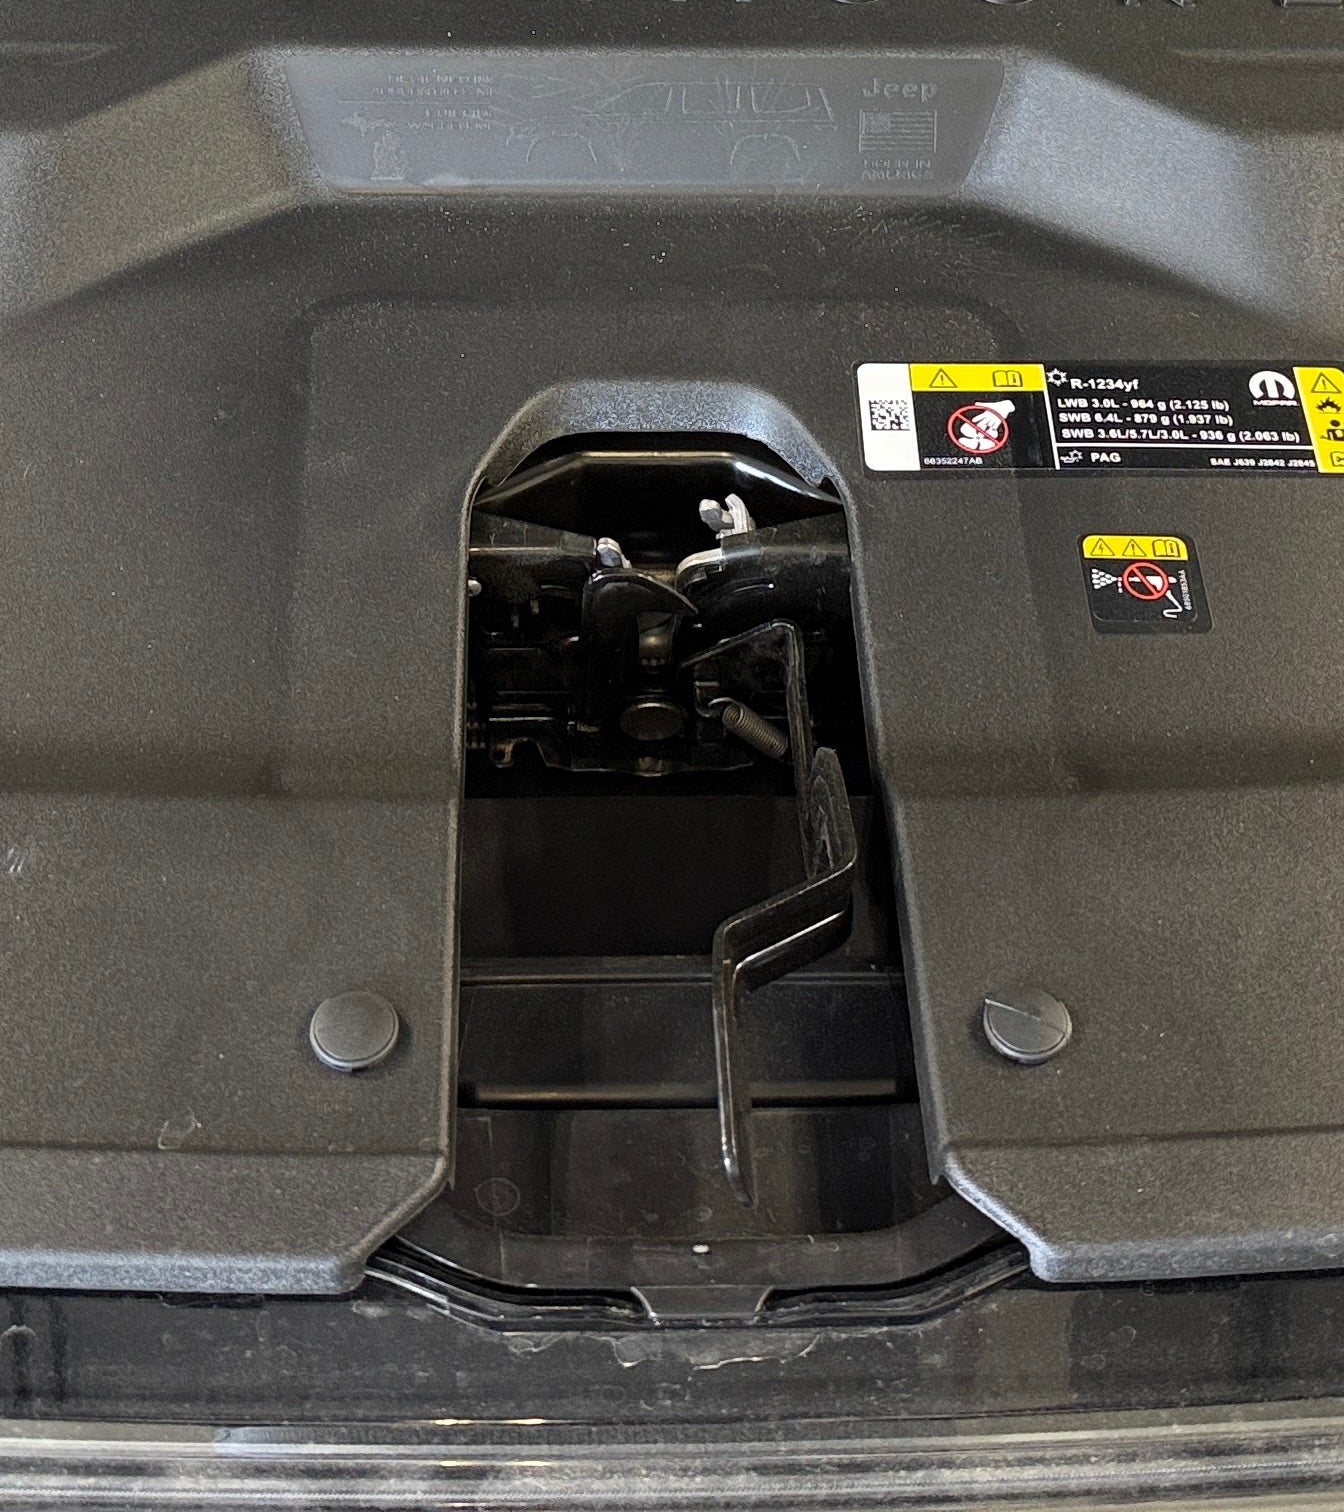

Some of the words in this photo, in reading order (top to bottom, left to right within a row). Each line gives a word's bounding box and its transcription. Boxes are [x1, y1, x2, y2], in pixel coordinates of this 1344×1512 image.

[861, 77, 937, 103] Jeep
[1069, 378, 1139, 392] R-1234yf
[1057, 398, 1089, 408] LWB
[1091, 398, 1120, 408] 3.0L
[1157, 401, 1167, 412] g
[1169, 399, 1209, 411] (2.125
[1211, 400, 1230, 412] lb)
[1058, 412, 1092, 423] SWB
[1160, 415, 1171, 426] g
[1172, 414, 1212, 426] (1.937
[1214, 414, 1234, 427] lb)
[1061, 428, 1095, 439] SWB
[1226, 432, 1237, 443] g
[1238, 430, 1279, 443] (2.063
[1281, 431, 1300, 444] lb)
[1090, 452, 1122, 463] PAG
